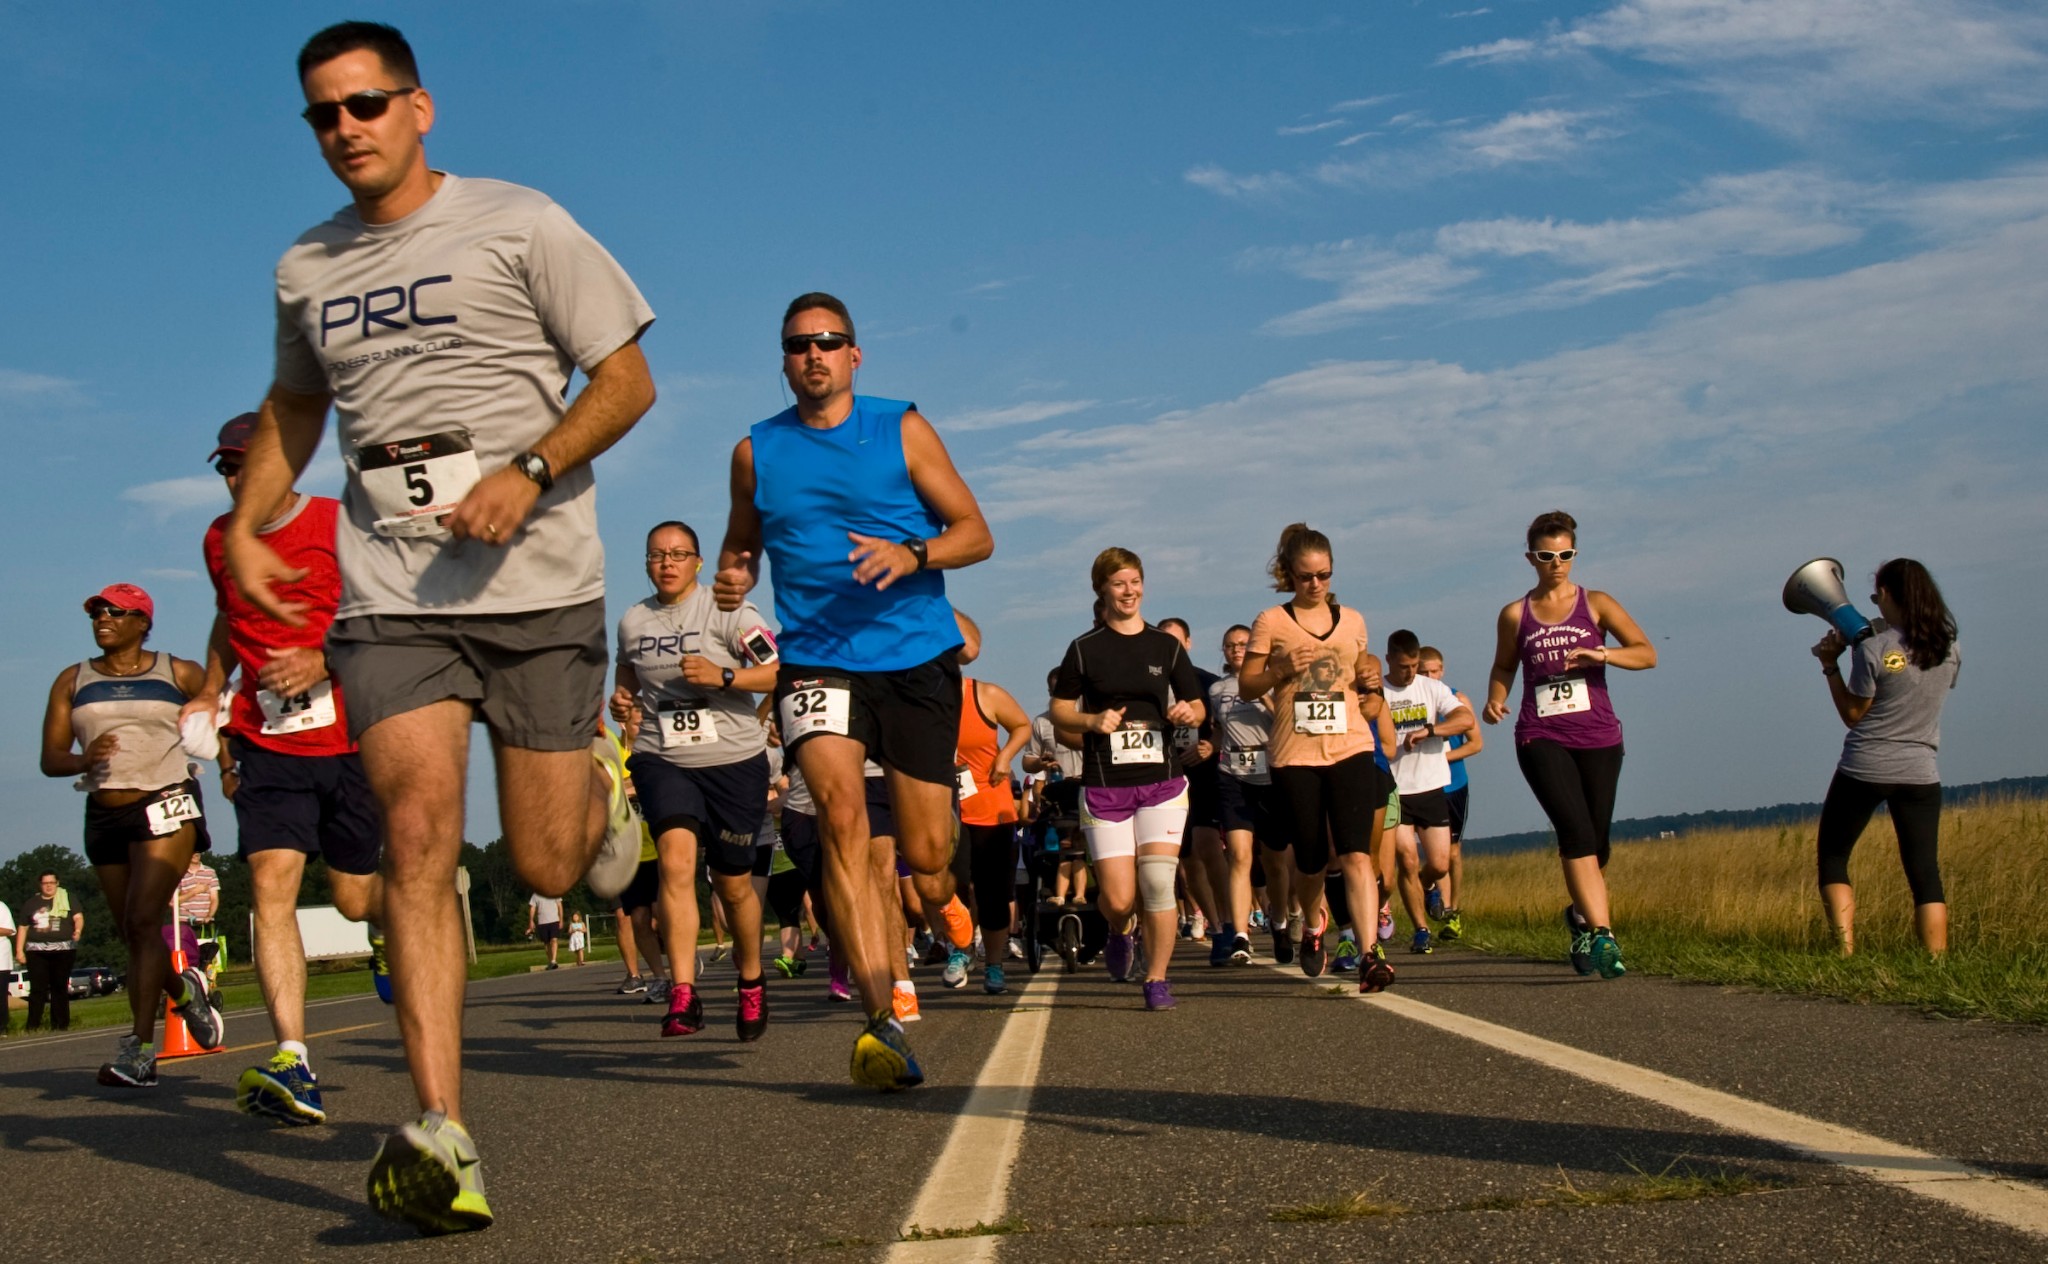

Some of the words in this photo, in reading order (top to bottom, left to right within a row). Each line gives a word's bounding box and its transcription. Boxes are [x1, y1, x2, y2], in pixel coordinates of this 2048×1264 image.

[321, 274, 458, 348] PRC
[371, 343, 424, 362] RUNNING
[426, 338, 463, 352] CLUB
[404, 464, 434, 507] 5
[1543, 635, 1569, 648] RUN
[1546, 625, 1592, 638] yourself
[639, 631, 700, 660] PRC
[1548, 650, 1559, 662] IT
[1549, 682, 1573, 702] 79
[793, 689, 827, 717] 32
[1307, 702, 1336, 720] 121
[673, 710, 700, 732] 89
[1121, 731, 1154, 750] 120
[1239, 753, 1256, 766] 94
